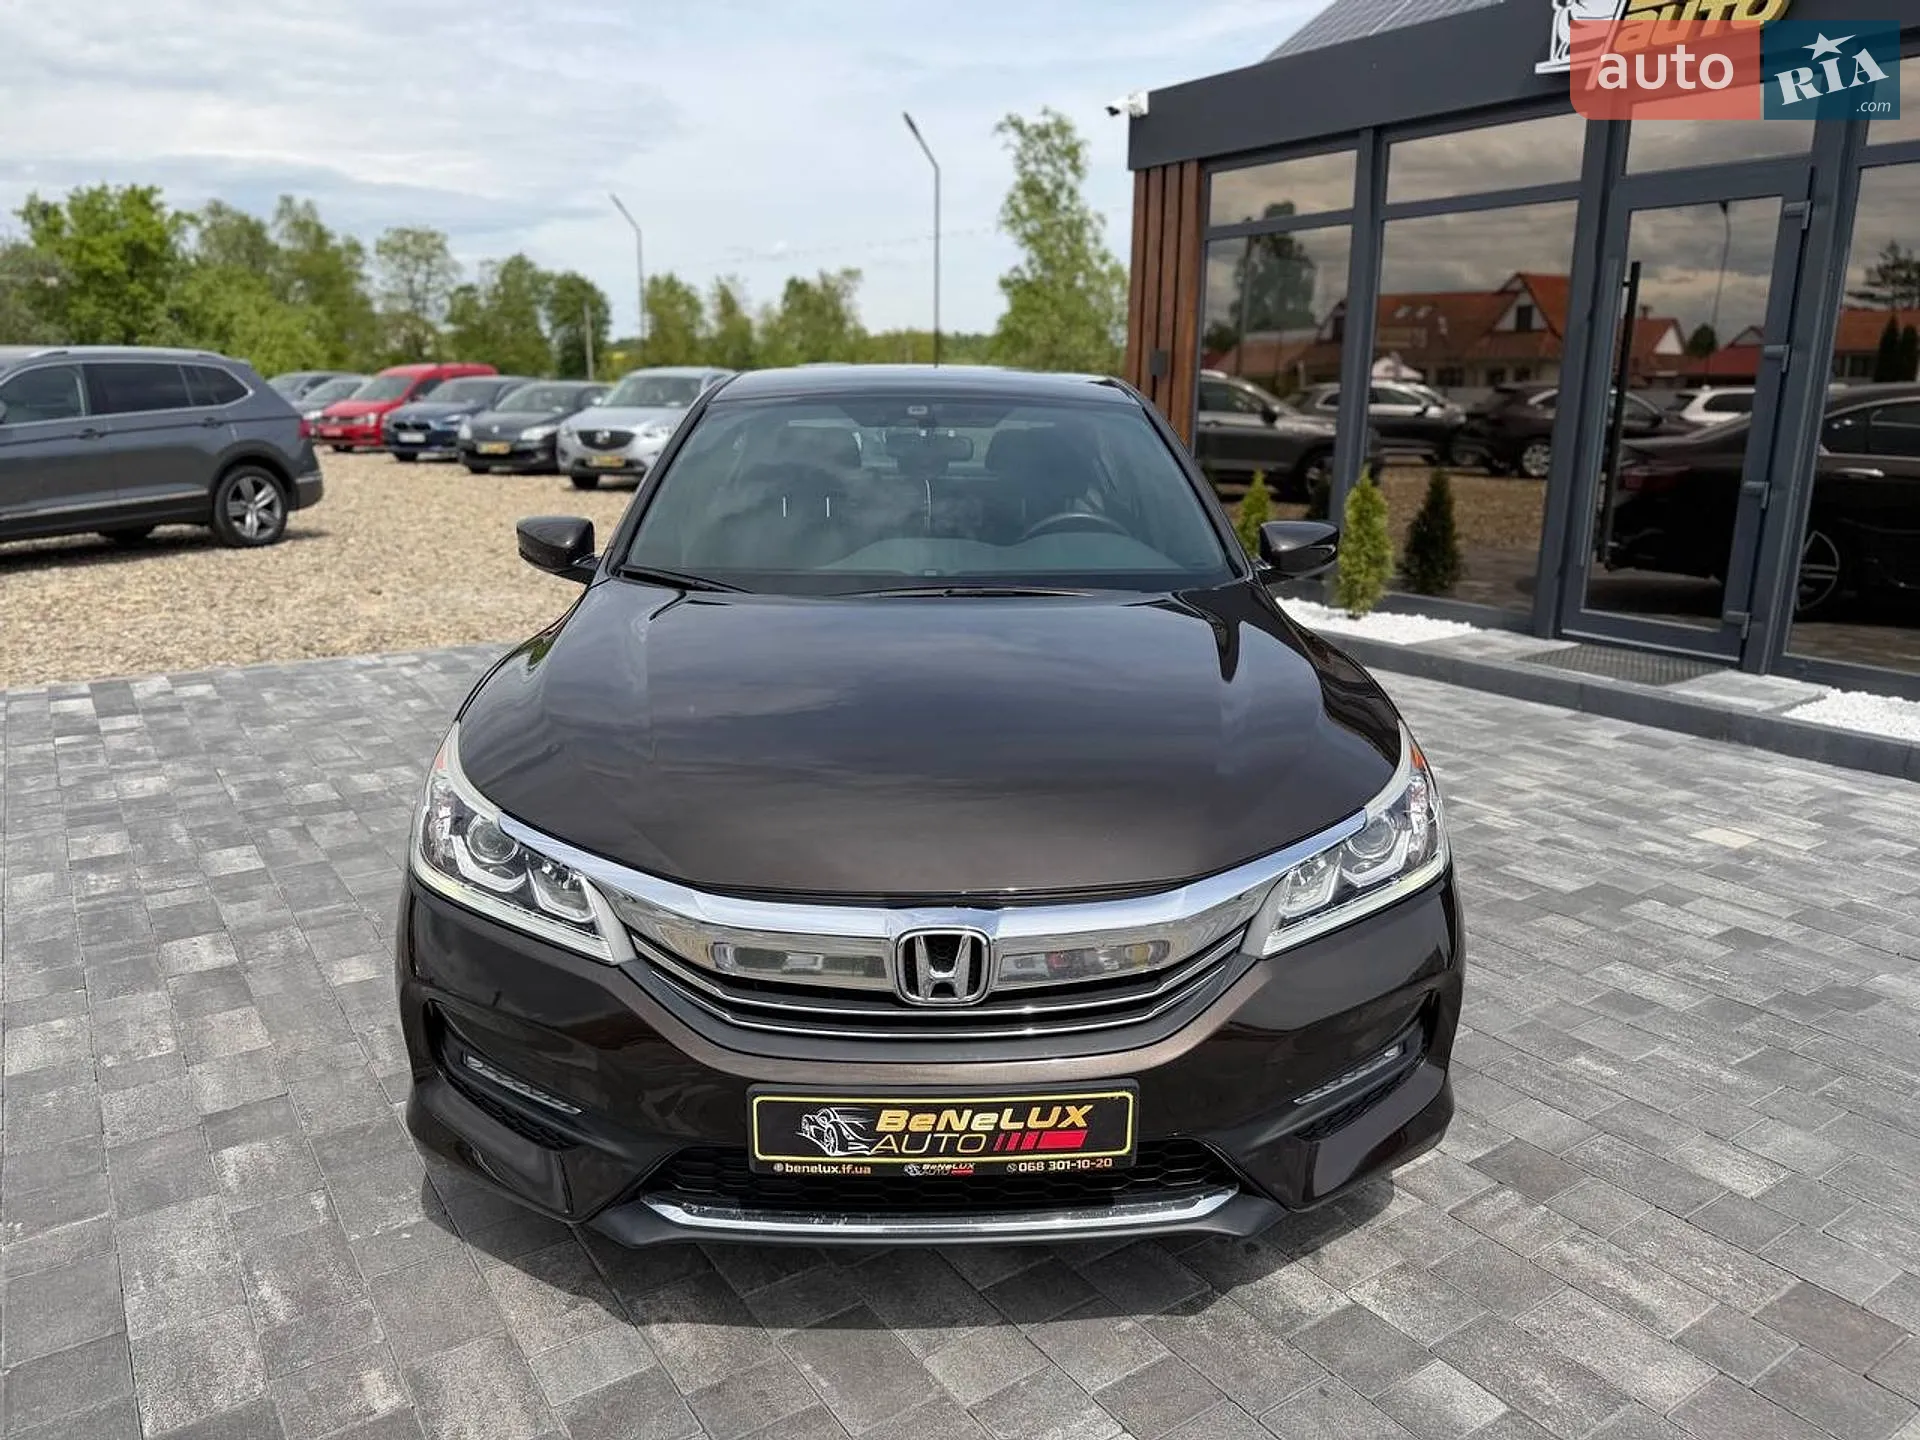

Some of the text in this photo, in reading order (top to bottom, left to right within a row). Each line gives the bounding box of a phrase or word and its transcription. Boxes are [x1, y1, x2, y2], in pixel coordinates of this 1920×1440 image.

[871, 1133, 987, 1154] AUTO
[785, 1163, 872, 1175] benelux.if.ua
[1018, 1157, 1113, 1173] 068 301-10-20
